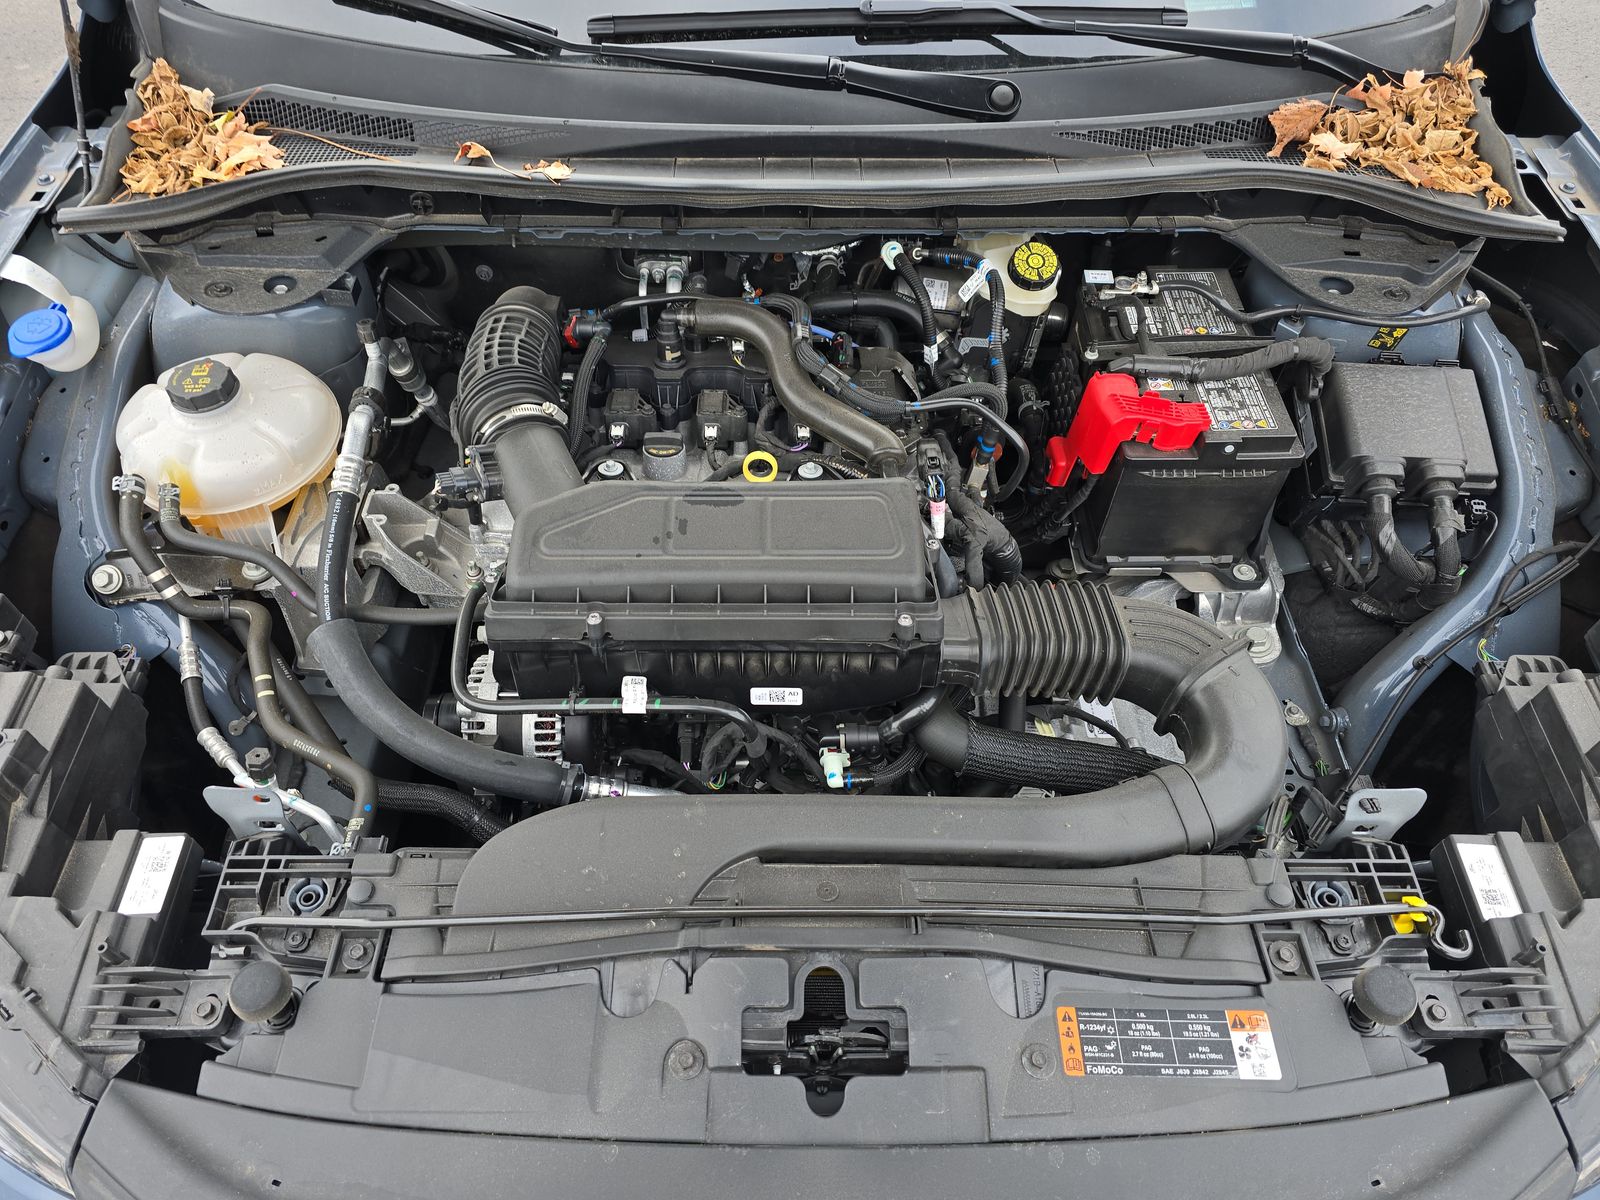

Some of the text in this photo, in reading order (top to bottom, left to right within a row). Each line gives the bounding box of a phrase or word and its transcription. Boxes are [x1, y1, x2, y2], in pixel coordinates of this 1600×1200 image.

[323, 594, 332, 621] SUCTION
[1079, 1023, 1107, 1033] R-1234yf
[1146, 1023, 1154, 1031] kg
[1203, 1024, 1212, 1032] kg
[1086, 1065, 1124, 1075] FoMoCo
